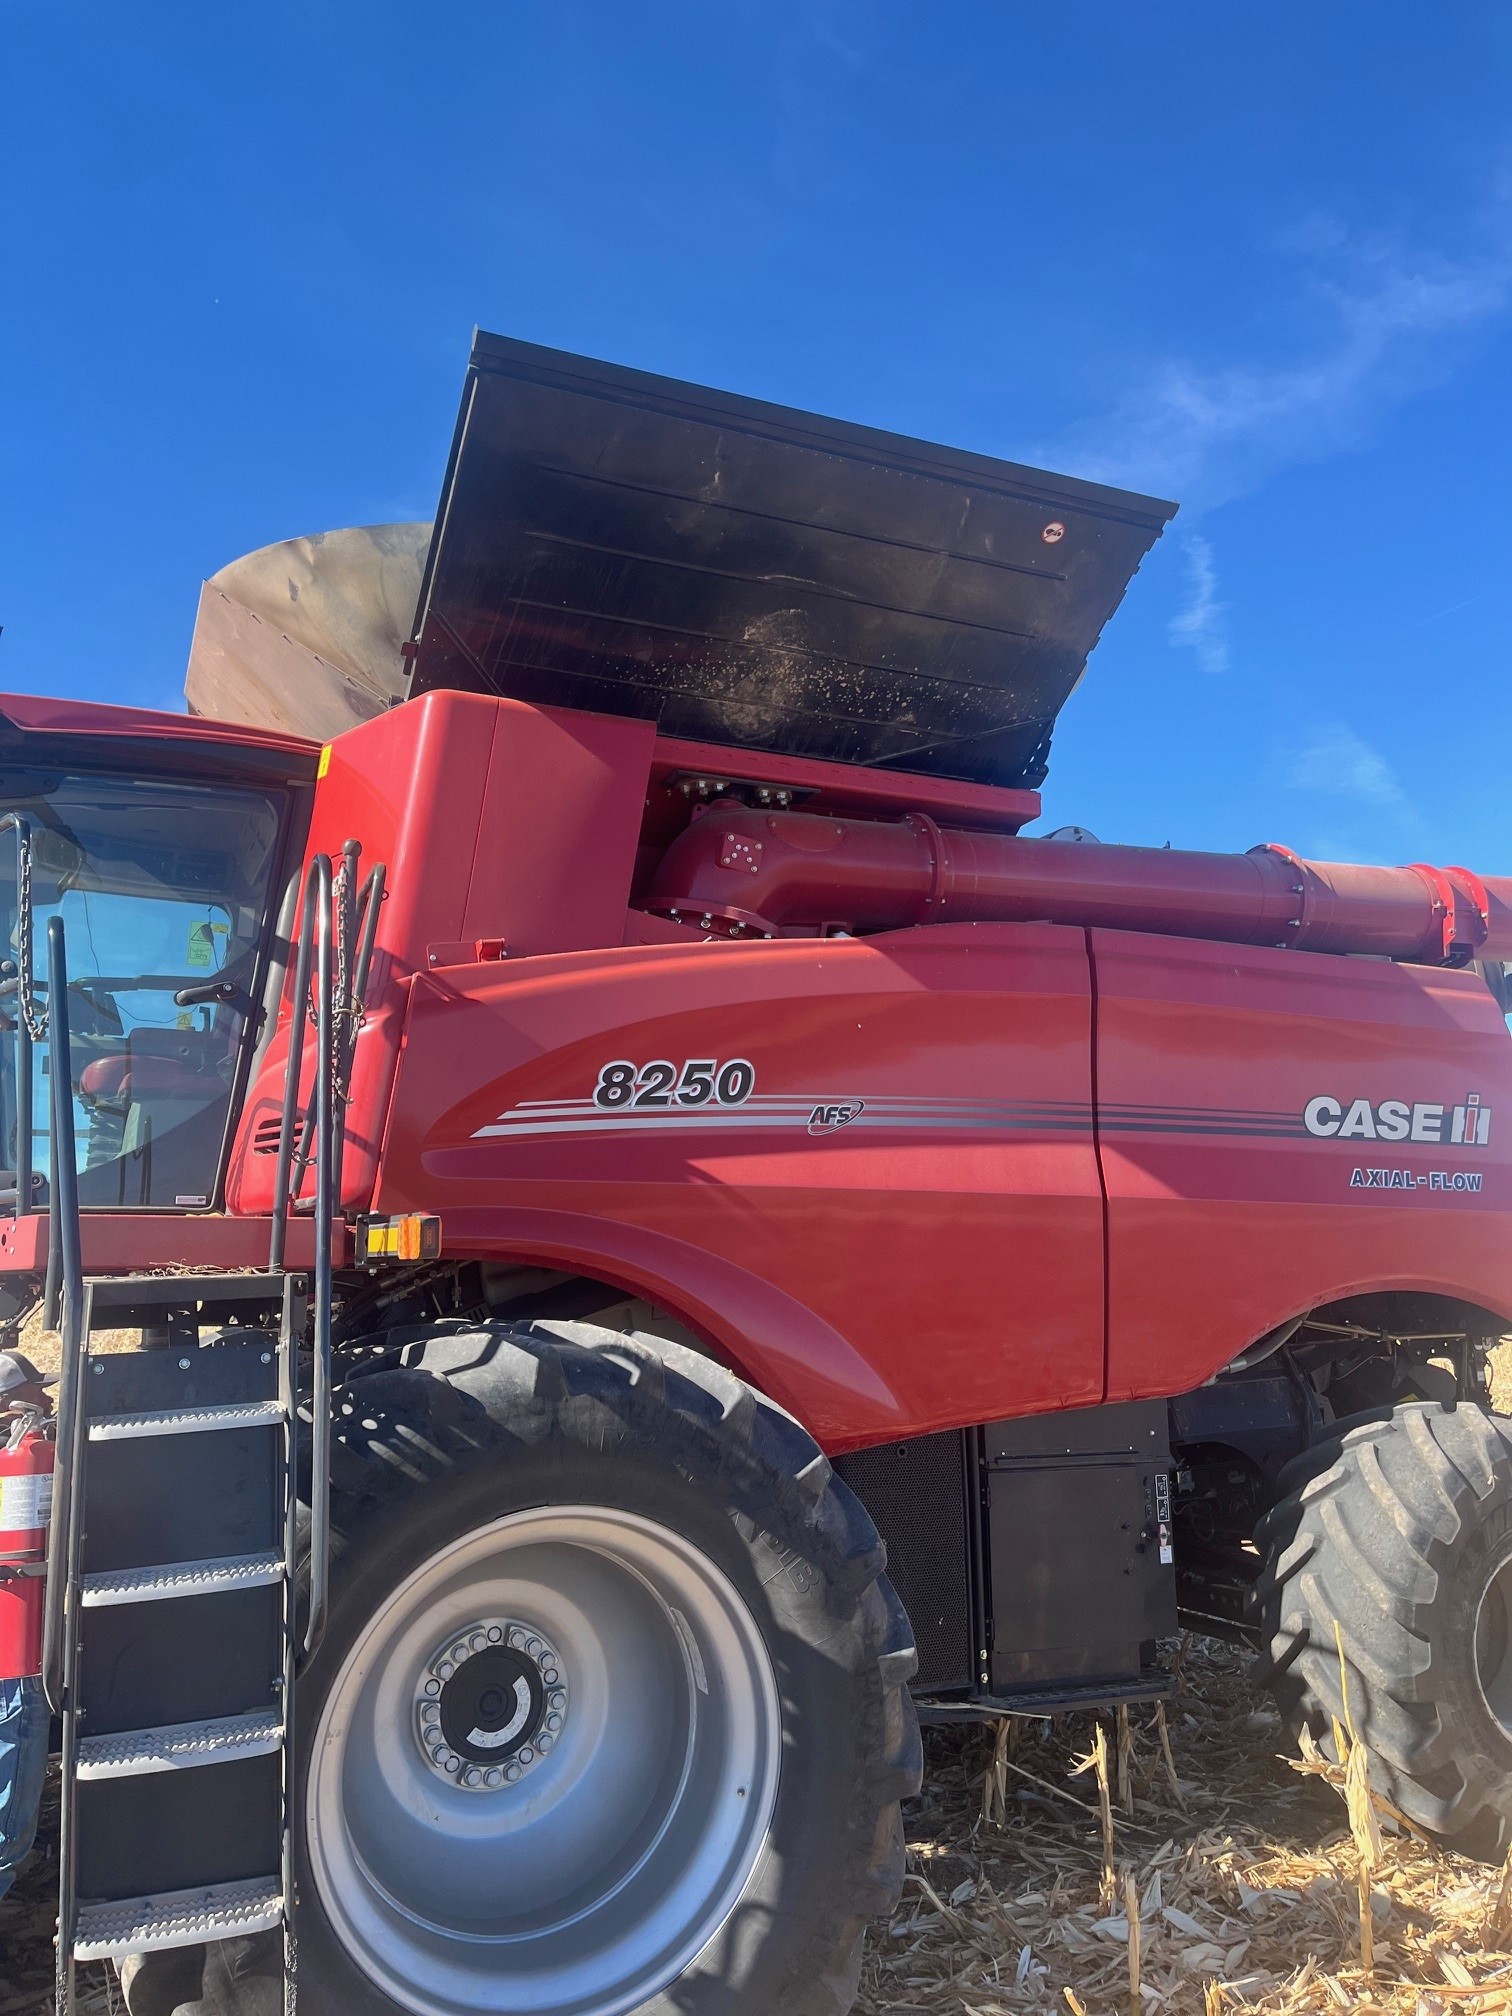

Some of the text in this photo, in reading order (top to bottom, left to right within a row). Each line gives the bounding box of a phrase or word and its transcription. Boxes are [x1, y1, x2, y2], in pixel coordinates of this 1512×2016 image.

[592, 1058, 756, 1110] 8250
[806, 1104, 852, 1126] AFS
[1304, 1096, 1444, 1142] CASE
[1350, 1168, 1483, 1192] AXIAL-FLOW
